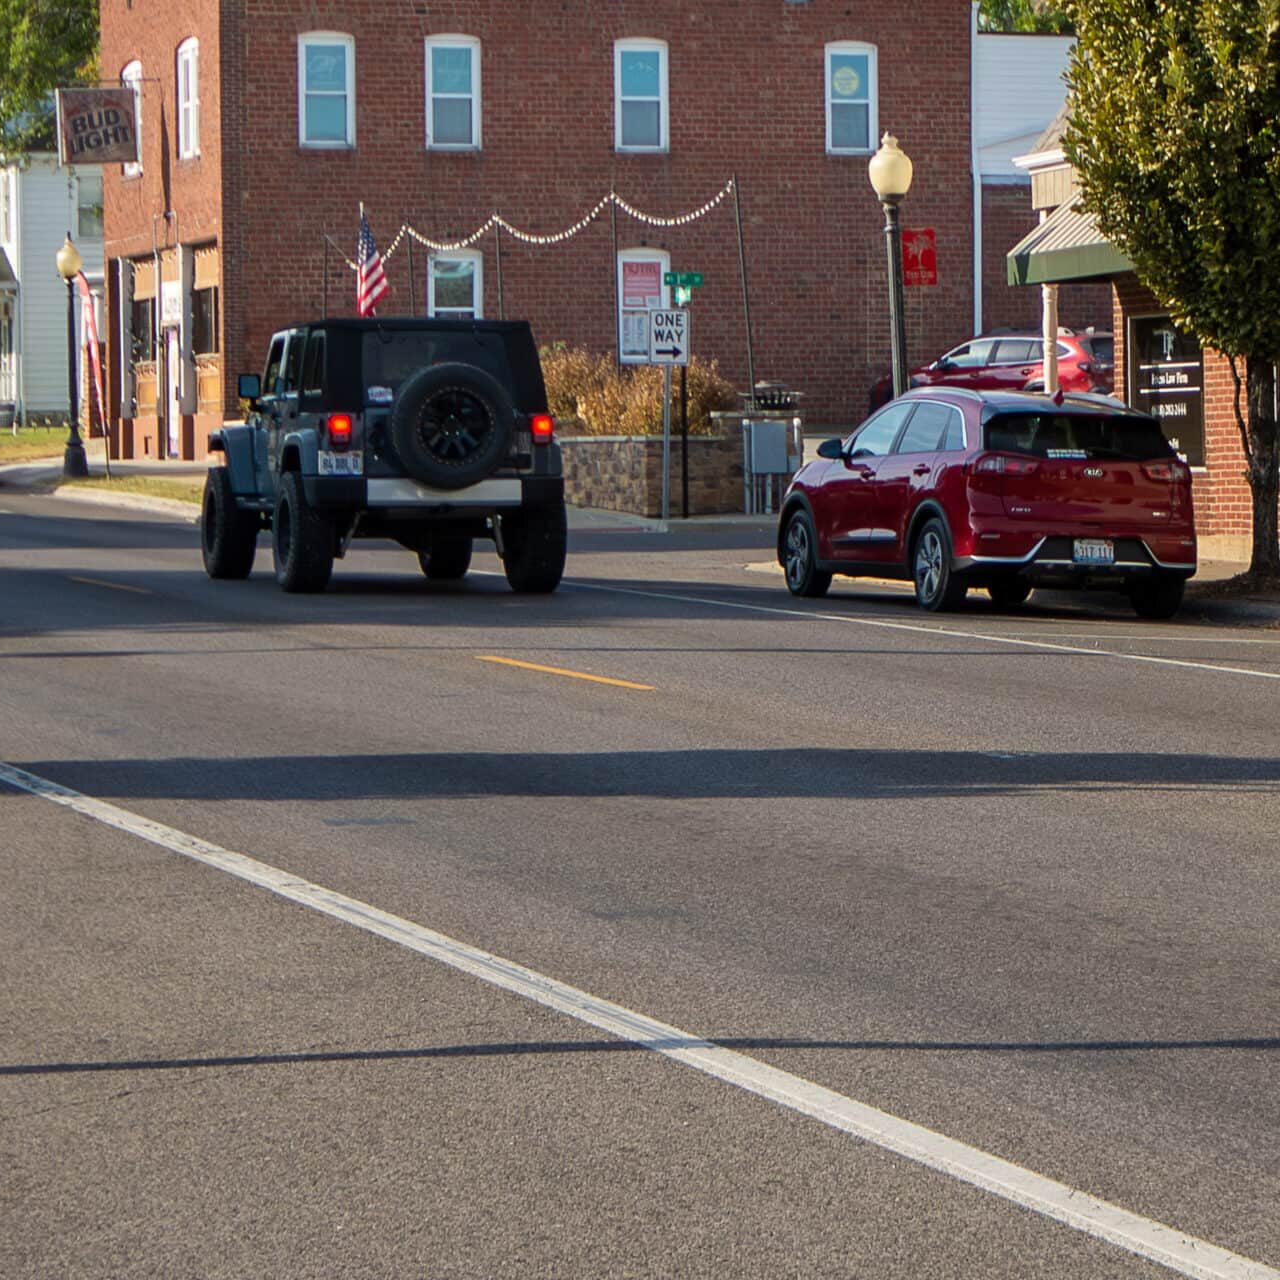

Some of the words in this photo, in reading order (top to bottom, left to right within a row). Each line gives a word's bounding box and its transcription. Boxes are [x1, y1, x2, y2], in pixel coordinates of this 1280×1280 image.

[72, 109, 120, 134] BUD
[70, 126, 129, 154] LIGHT
[655, 314, 683, 327] ONE
[654, 329, 683, 342] WAY
